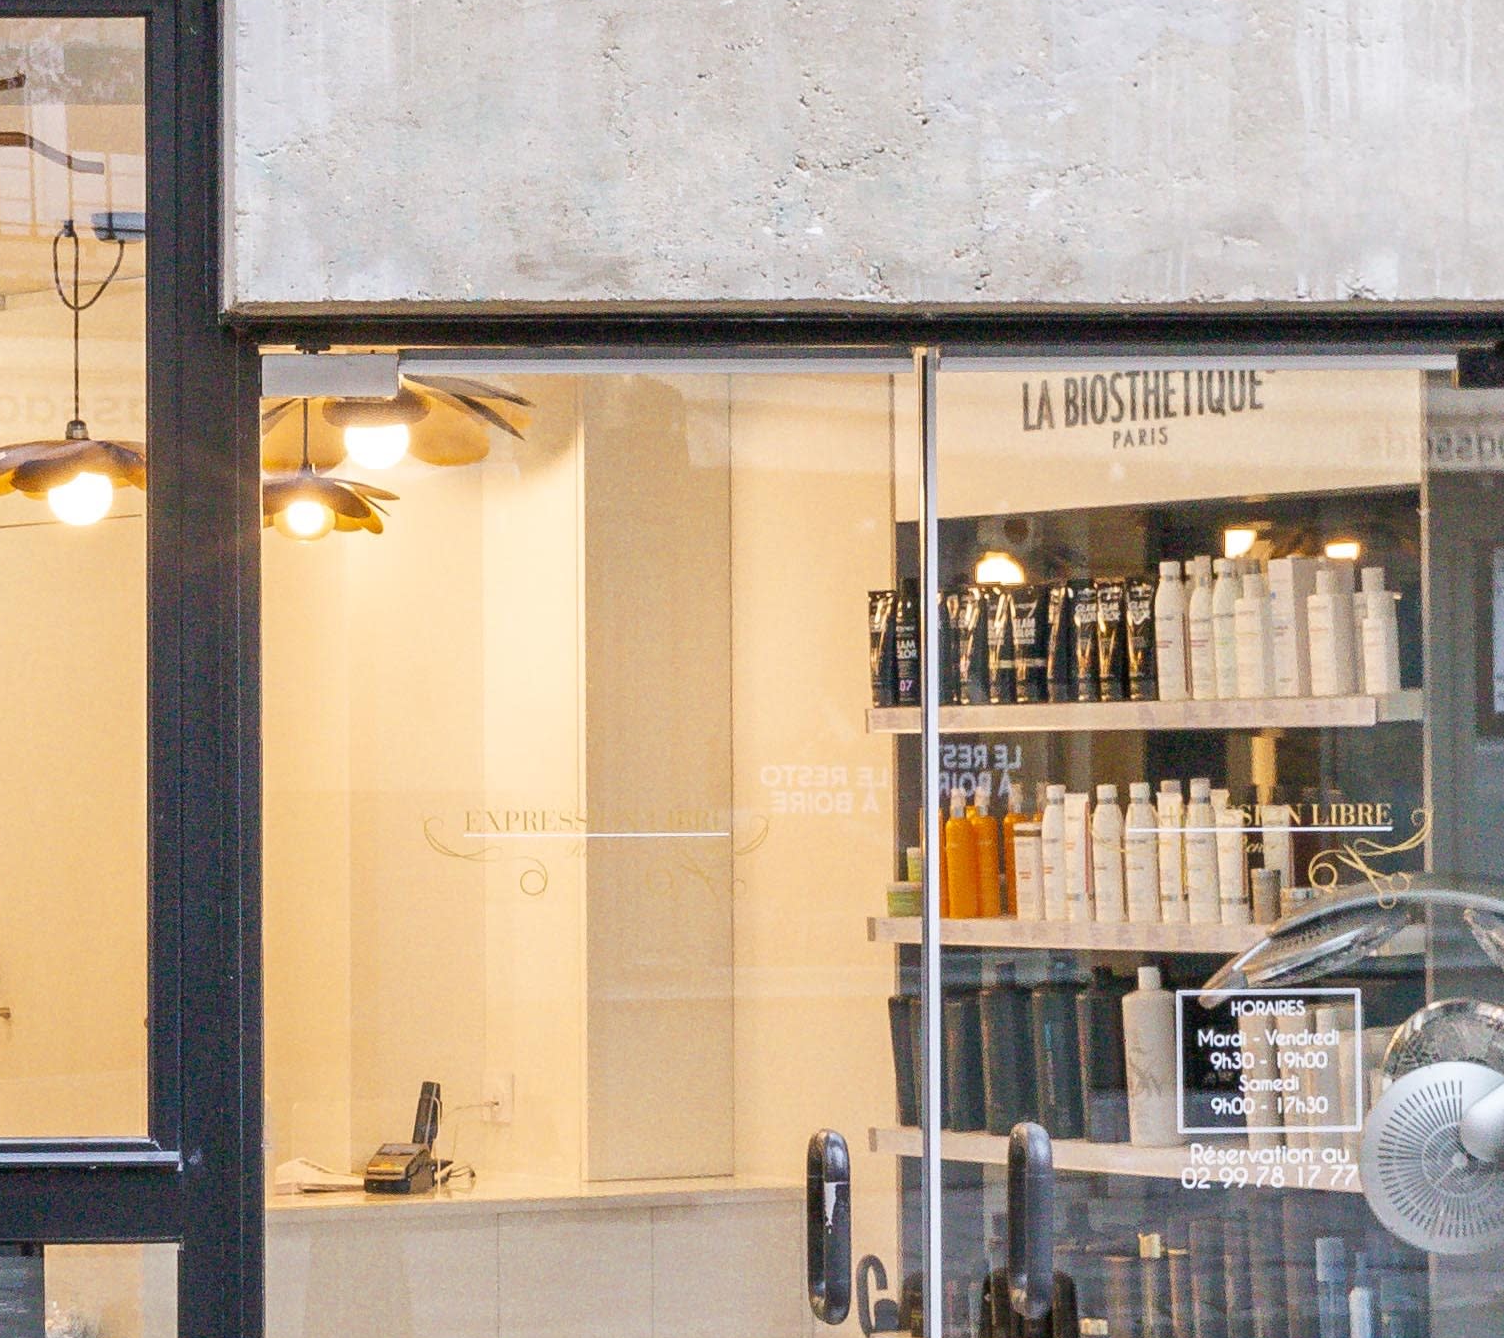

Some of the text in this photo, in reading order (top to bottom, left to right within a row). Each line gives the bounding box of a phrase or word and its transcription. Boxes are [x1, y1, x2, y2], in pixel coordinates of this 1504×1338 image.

[1022, 380, 1054, 431] LA
[1112, 427, 1169, 449] PARIS
[1312, 803, 1395, 827] LIBRE
[1231, 1000, 1307, 1017] HORAIRES
[1197, 1029, 1247, 1048] Mardi
[1265, 1029, 1340, 1046] Vendredi
[1210, 1052, 1255, 1070] 9h30
[1276, 1051, 1329, 1070] 19h00
[1238, 1074, 1300, 1092] Samedi
[1210, 1097, 1255, 1116] 9h00
[1276, 1096, 1329, 1115] 17h30
[1190, 1142, 1350, 1166] Réservation au
[1181, 1164, 1359, 1190] 02 99 78 17 77
